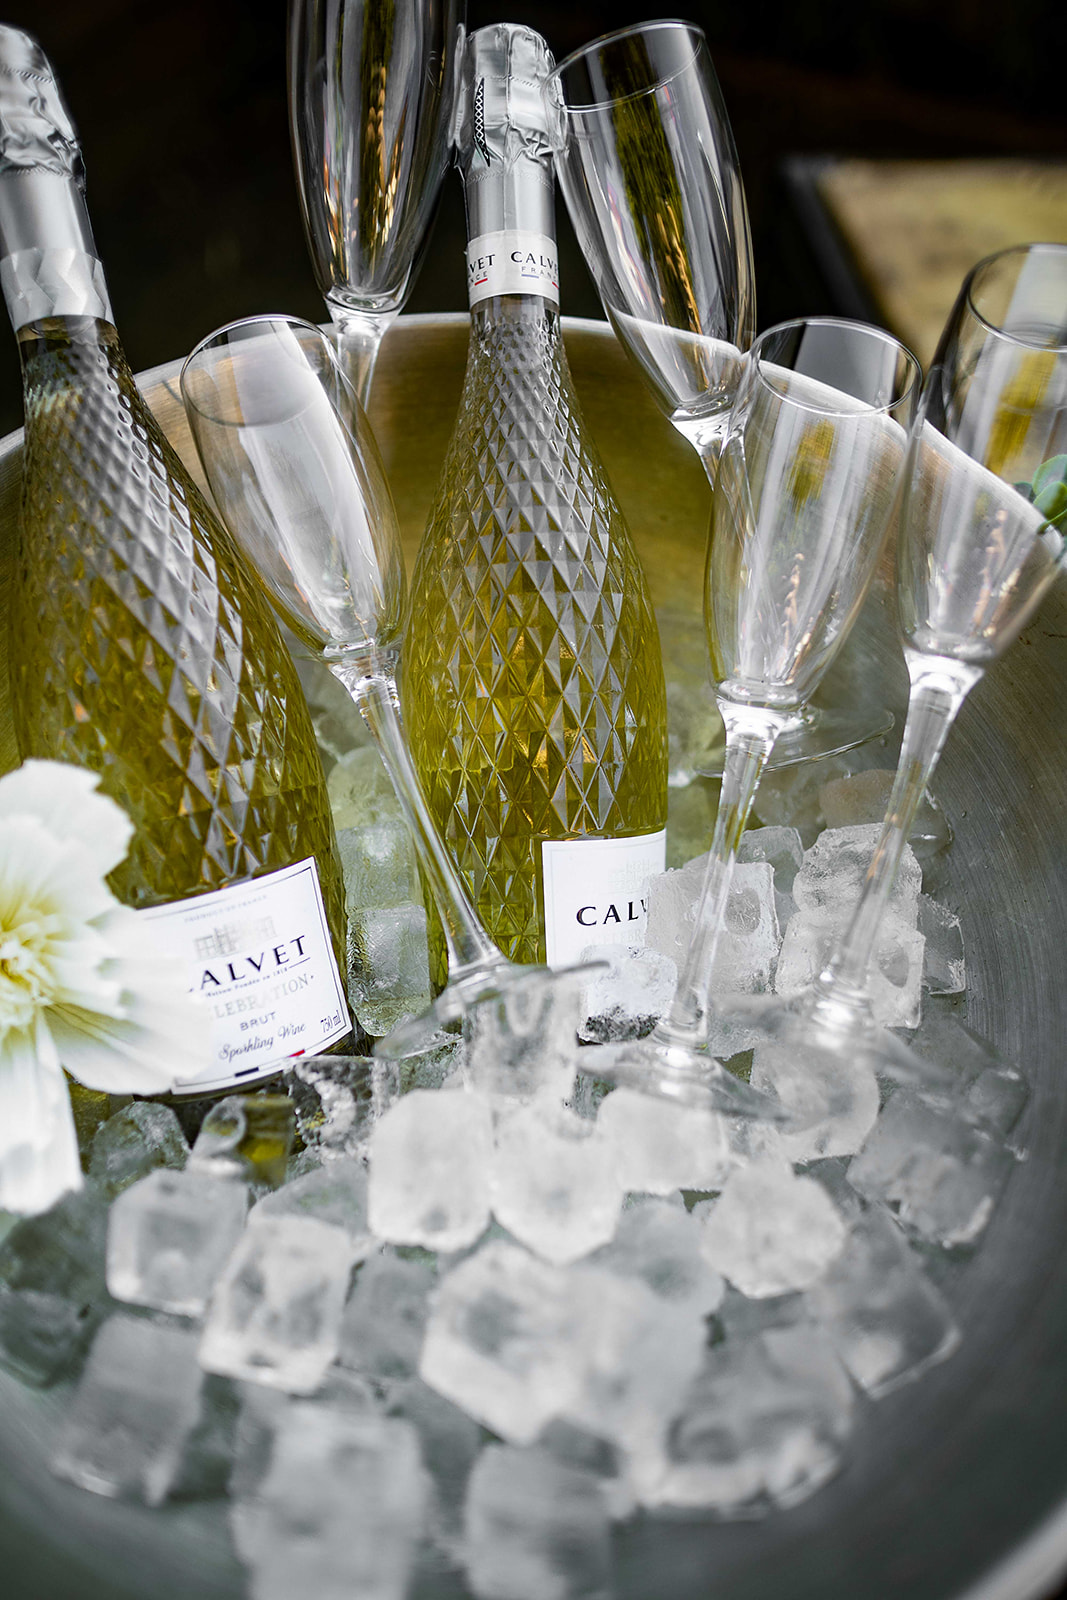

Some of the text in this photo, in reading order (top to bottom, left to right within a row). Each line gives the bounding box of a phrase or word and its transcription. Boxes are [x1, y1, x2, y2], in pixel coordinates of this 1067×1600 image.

[470, 254, 496, 273] VET
[201, 935, 305, 990] ALVET
[240, 1011, 276, 1031] BRUT
[218, 1023, 306, 1062] Sparkling Wine
